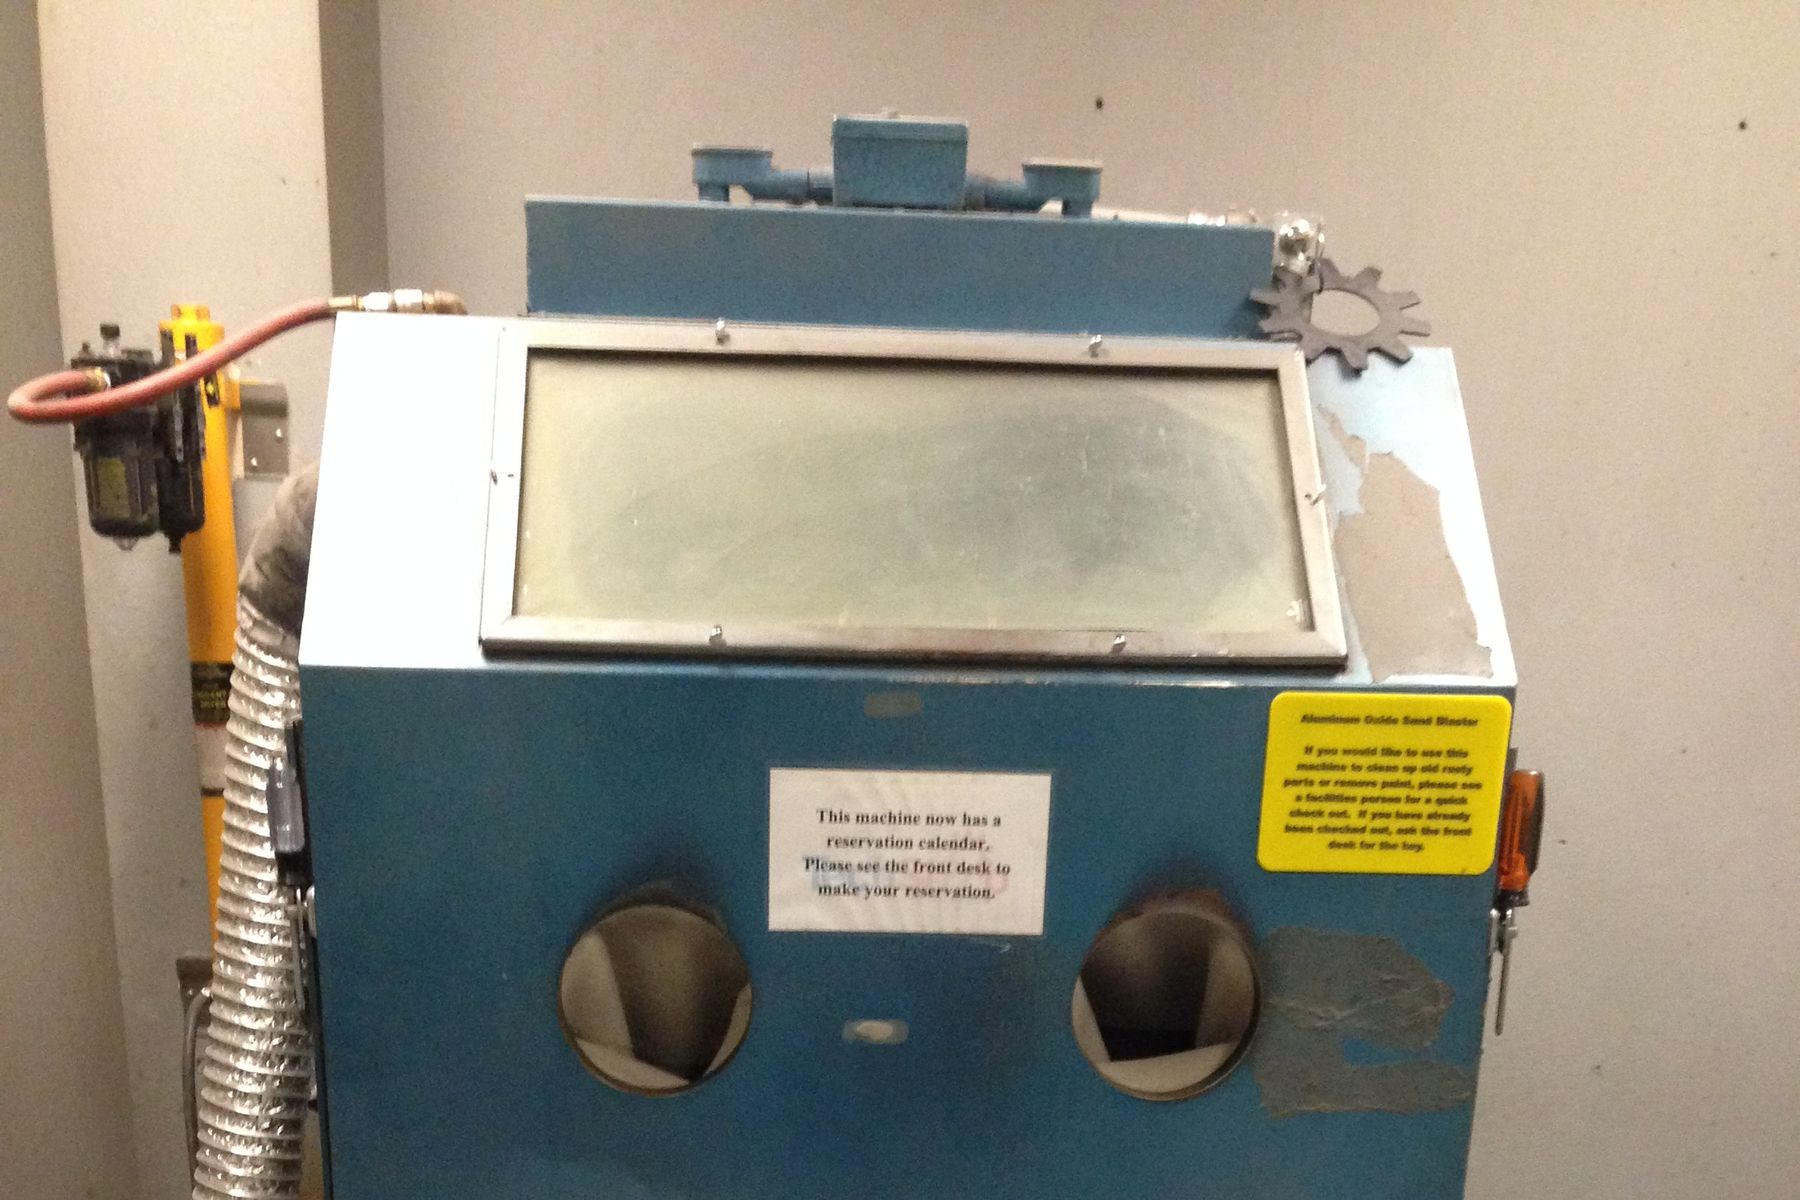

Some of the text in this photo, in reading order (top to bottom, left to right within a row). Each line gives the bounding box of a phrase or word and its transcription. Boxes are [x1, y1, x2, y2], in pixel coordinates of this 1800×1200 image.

[1403, 716, 1433, 725] Sand
[1436, 717, 1478, 726] Blaster
[1304, 745, 1313, 755] If
[1317, 748, 1338, 757] you
[1343, 748, 1377, 756] would
[1381, 748, 1402, 756] like
[1446, 749, 1469, 758] this
[1297, 763, 1473, 775] machine to clean up old rusty
[1284, 779, 1314, 787] parts
[1380, 780, 1414, 789] paint,
[1418, 781, 1457, 789] please
[1306, 794, 1357, 802] facilities
[1360, 796, 1401, 804] person
[1405, 795, 1420, 803] for
[1436, 797, 1467, 806] quick
[816, 810, 1001, 826] This machine now has a
[1358, 810, 1367, 818] If
[1371, 812, 1392, 820] you
[1395, 811, 1422, 819] have
[1427, 812, 1471, 822] already
[1284, 825, 1313, 833] been
[1317, 825, 1366, 833] checked
[1421, 827, 1439, 835] the
[1443, 827, 1472, 836] front
[826, 834, 990, 851] reservation calendar.
[1328, 841, 1355, 849] desk
[1359, 841, 1375, 849] for
[1379, 841, 1398, 850] the
[803, 858, 1010, 876] Please see the front desk to
[818, 884, 995, 900] make your reservation.
